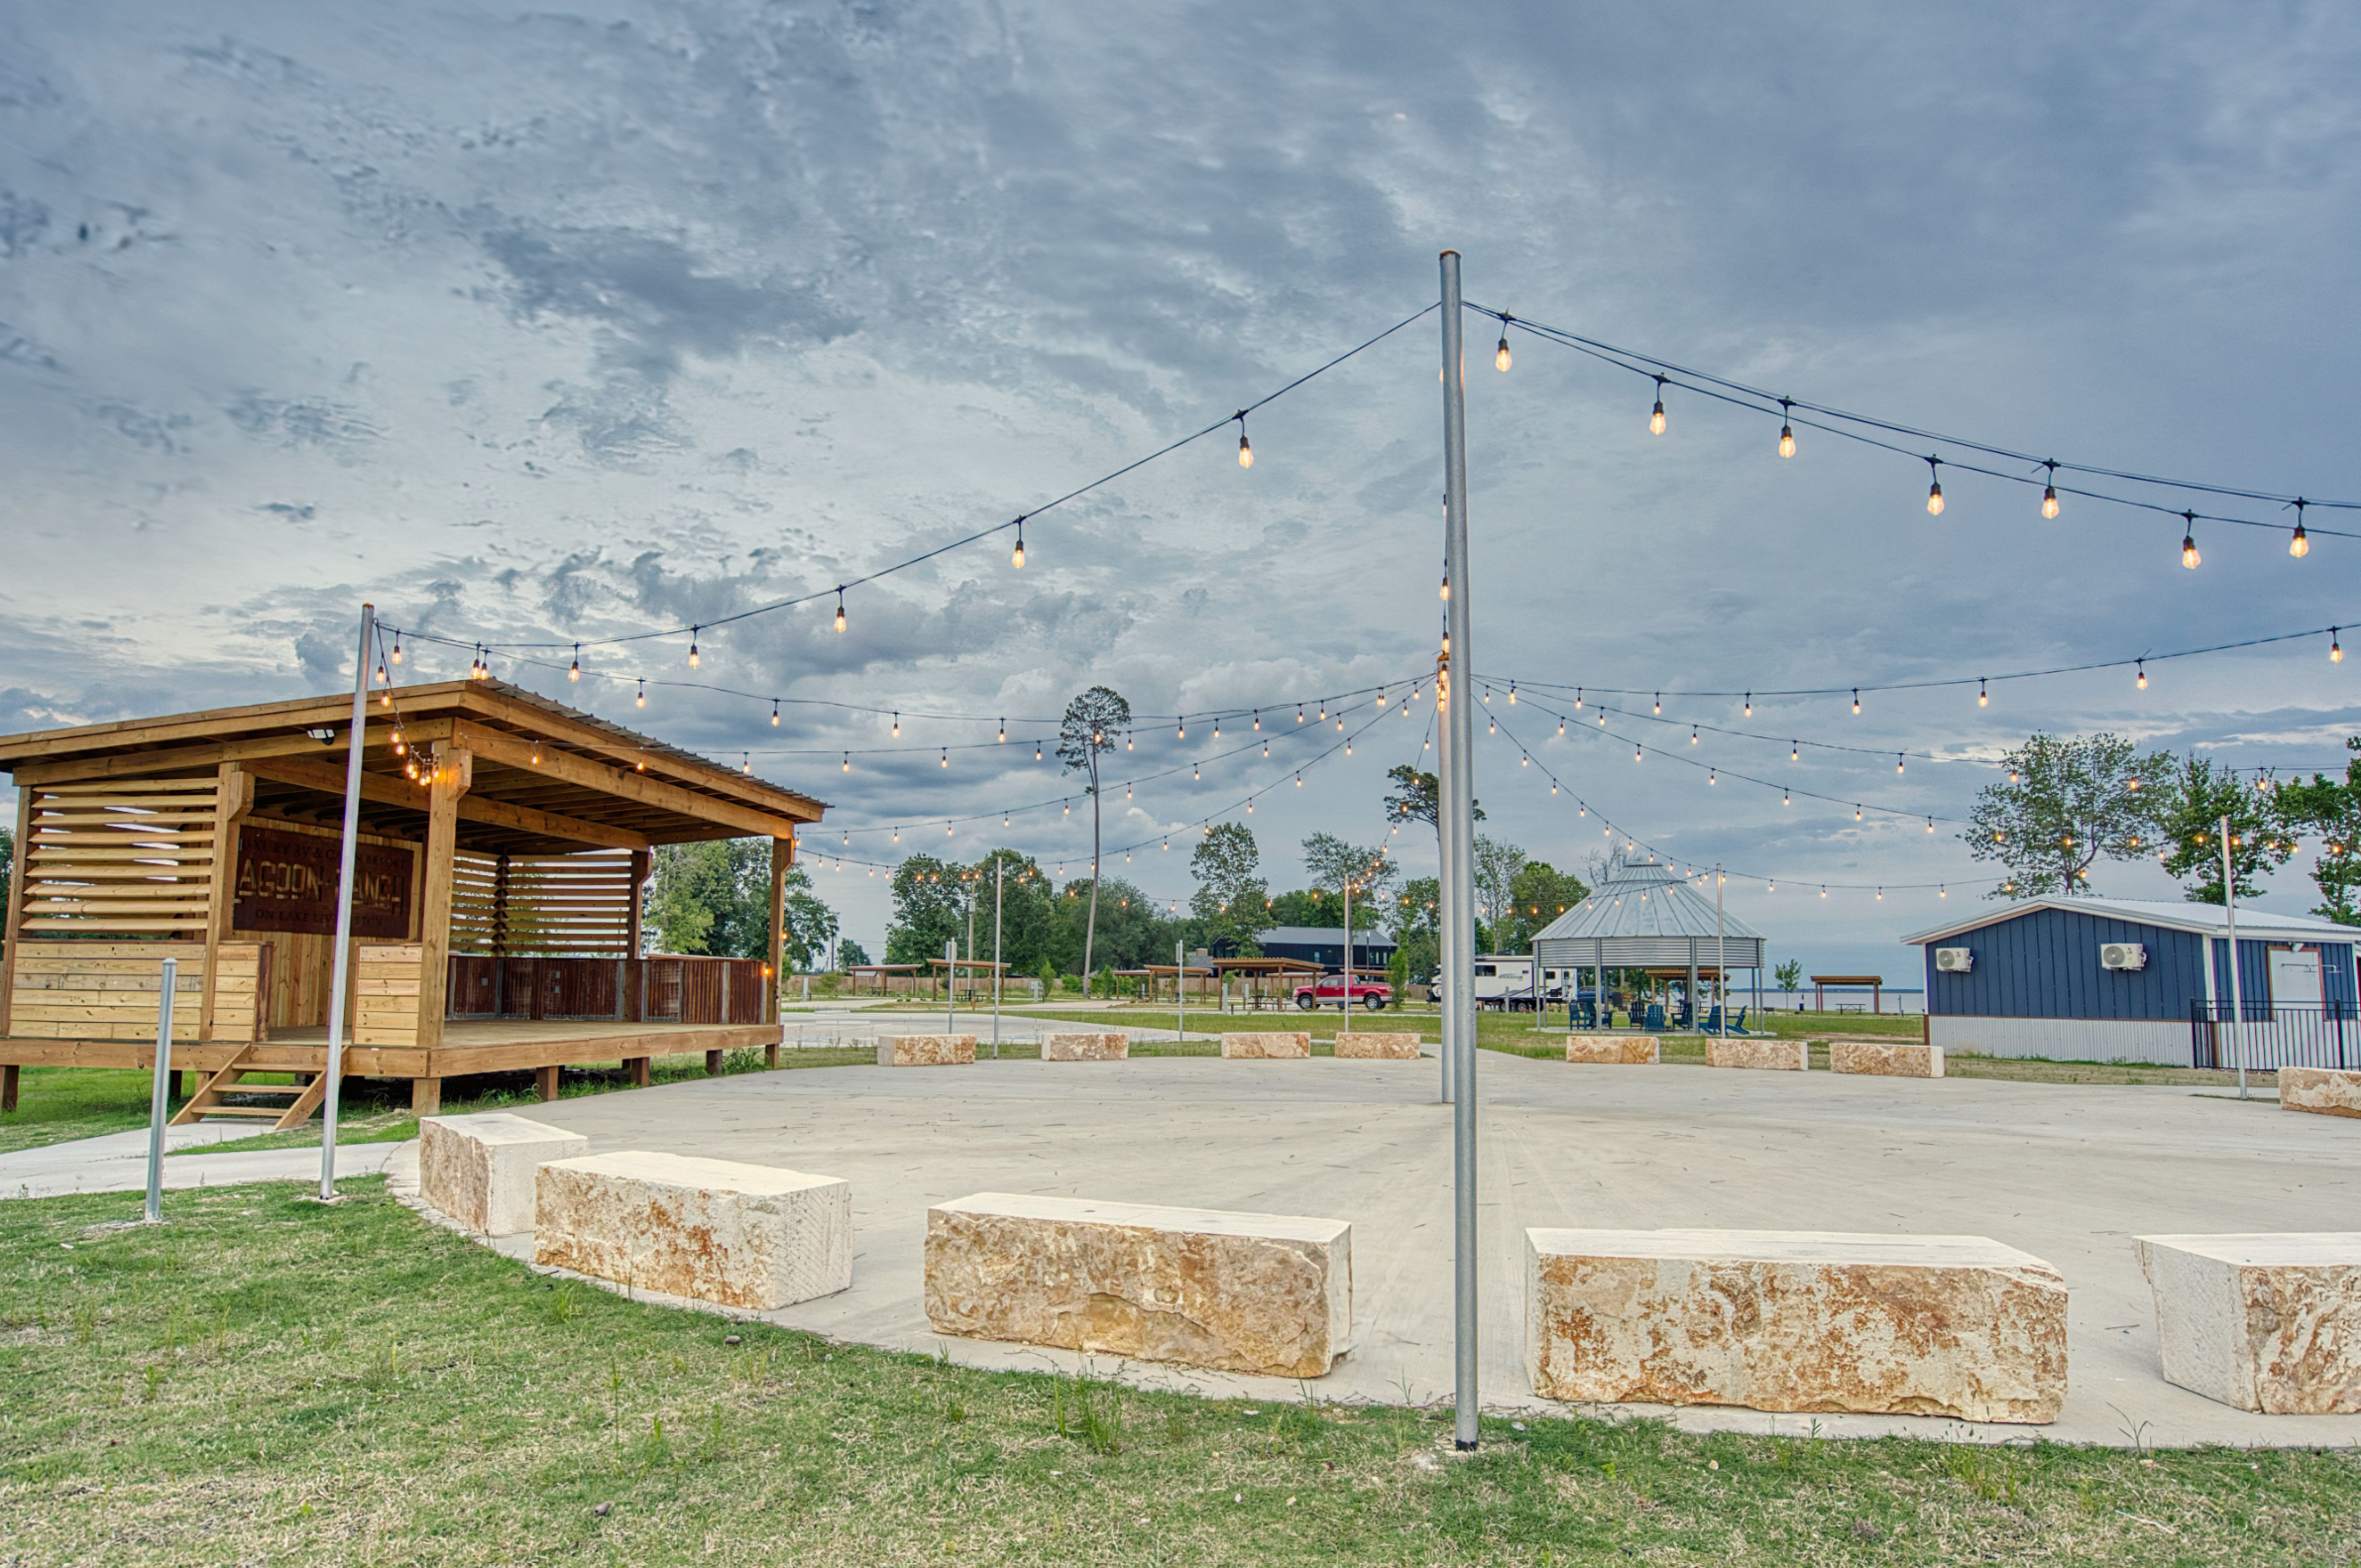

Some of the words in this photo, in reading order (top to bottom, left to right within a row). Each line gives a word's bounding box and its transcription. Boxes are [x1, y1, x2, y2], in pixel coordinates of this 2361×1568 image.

[241, 838, 289, 854] UXURY
[293, 842, 311, 857] RV
[315, 847, 324, 859] &
[366, 854, 407, 868] RESORT
[235, 858, 324, 903] AGOON
[255, 908, 275, 920] ON
[280, 911, 309, 923] LAKE
